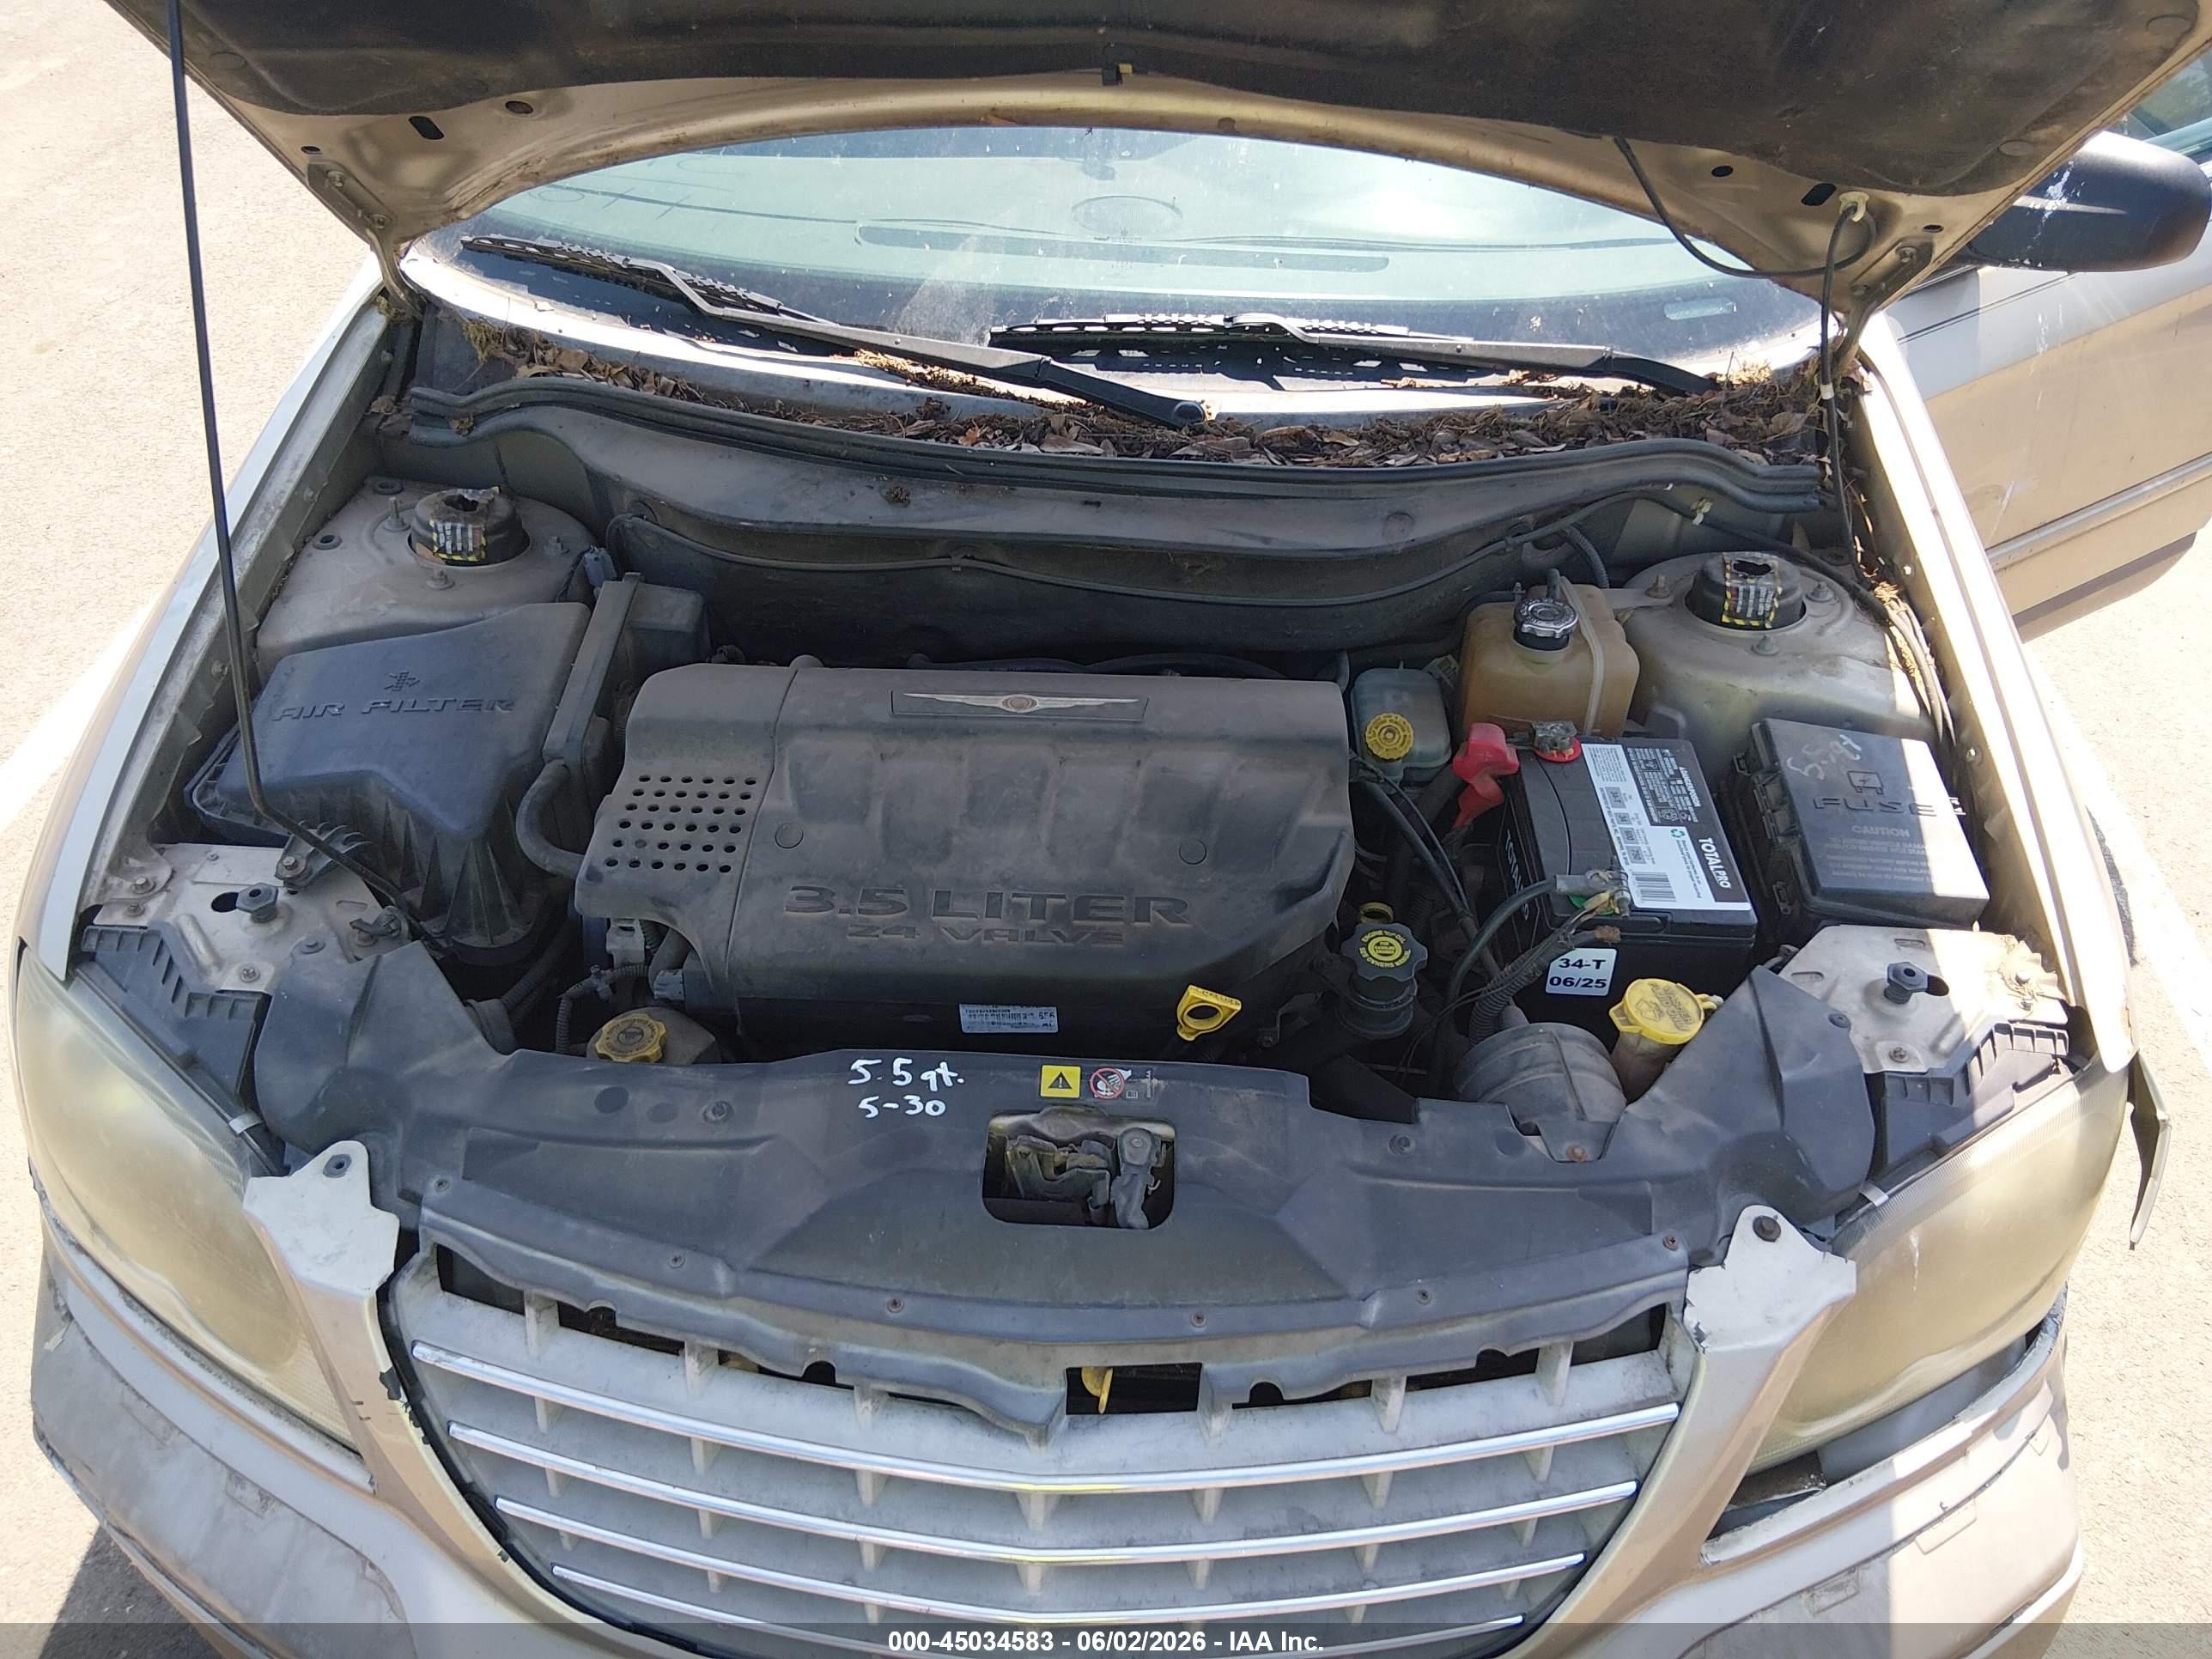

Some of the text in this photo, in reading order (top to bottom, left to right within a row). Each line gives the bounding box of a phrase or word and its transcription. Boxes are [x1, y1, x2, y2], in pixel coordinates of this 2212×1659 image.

[273, 697, 515, 722] AIR FILTER
[1814, 796, 1937, 817] FUSE
[1851, 824, 1911, 838] CAUTION
[783, 884, 1194, 927] 3.5 LITER
[848, 924, 1126, 945] 24 VALVE
[1559, 957, 1607, 970] 34-T
[1549, 975, 1607, 989] 06/25
[858, 1095, 946, 1118] 5-30
